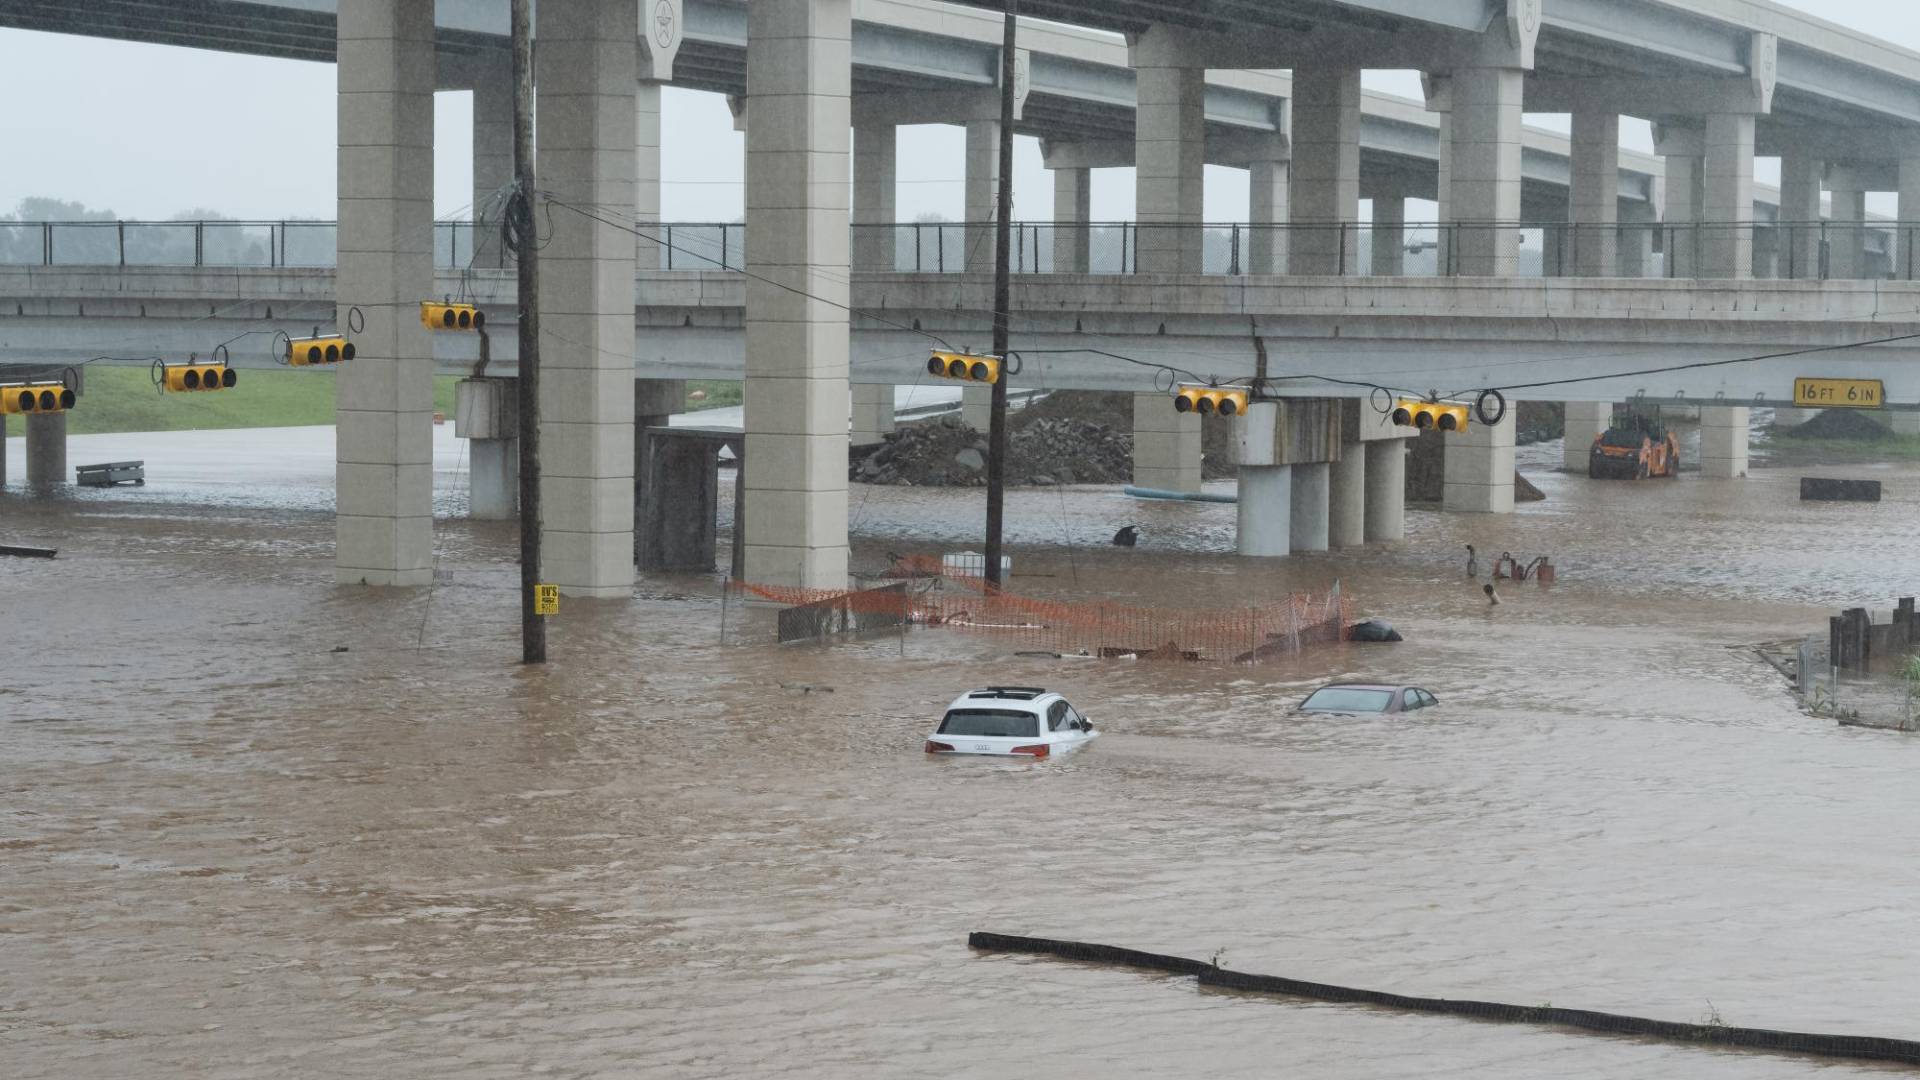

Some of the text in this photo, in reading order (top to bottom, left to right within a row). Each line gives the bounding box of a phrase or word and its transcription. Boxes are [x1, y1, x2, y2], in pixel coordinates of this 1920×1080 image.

[1802, 384, 1874, 401] 16 FT 6 IN
